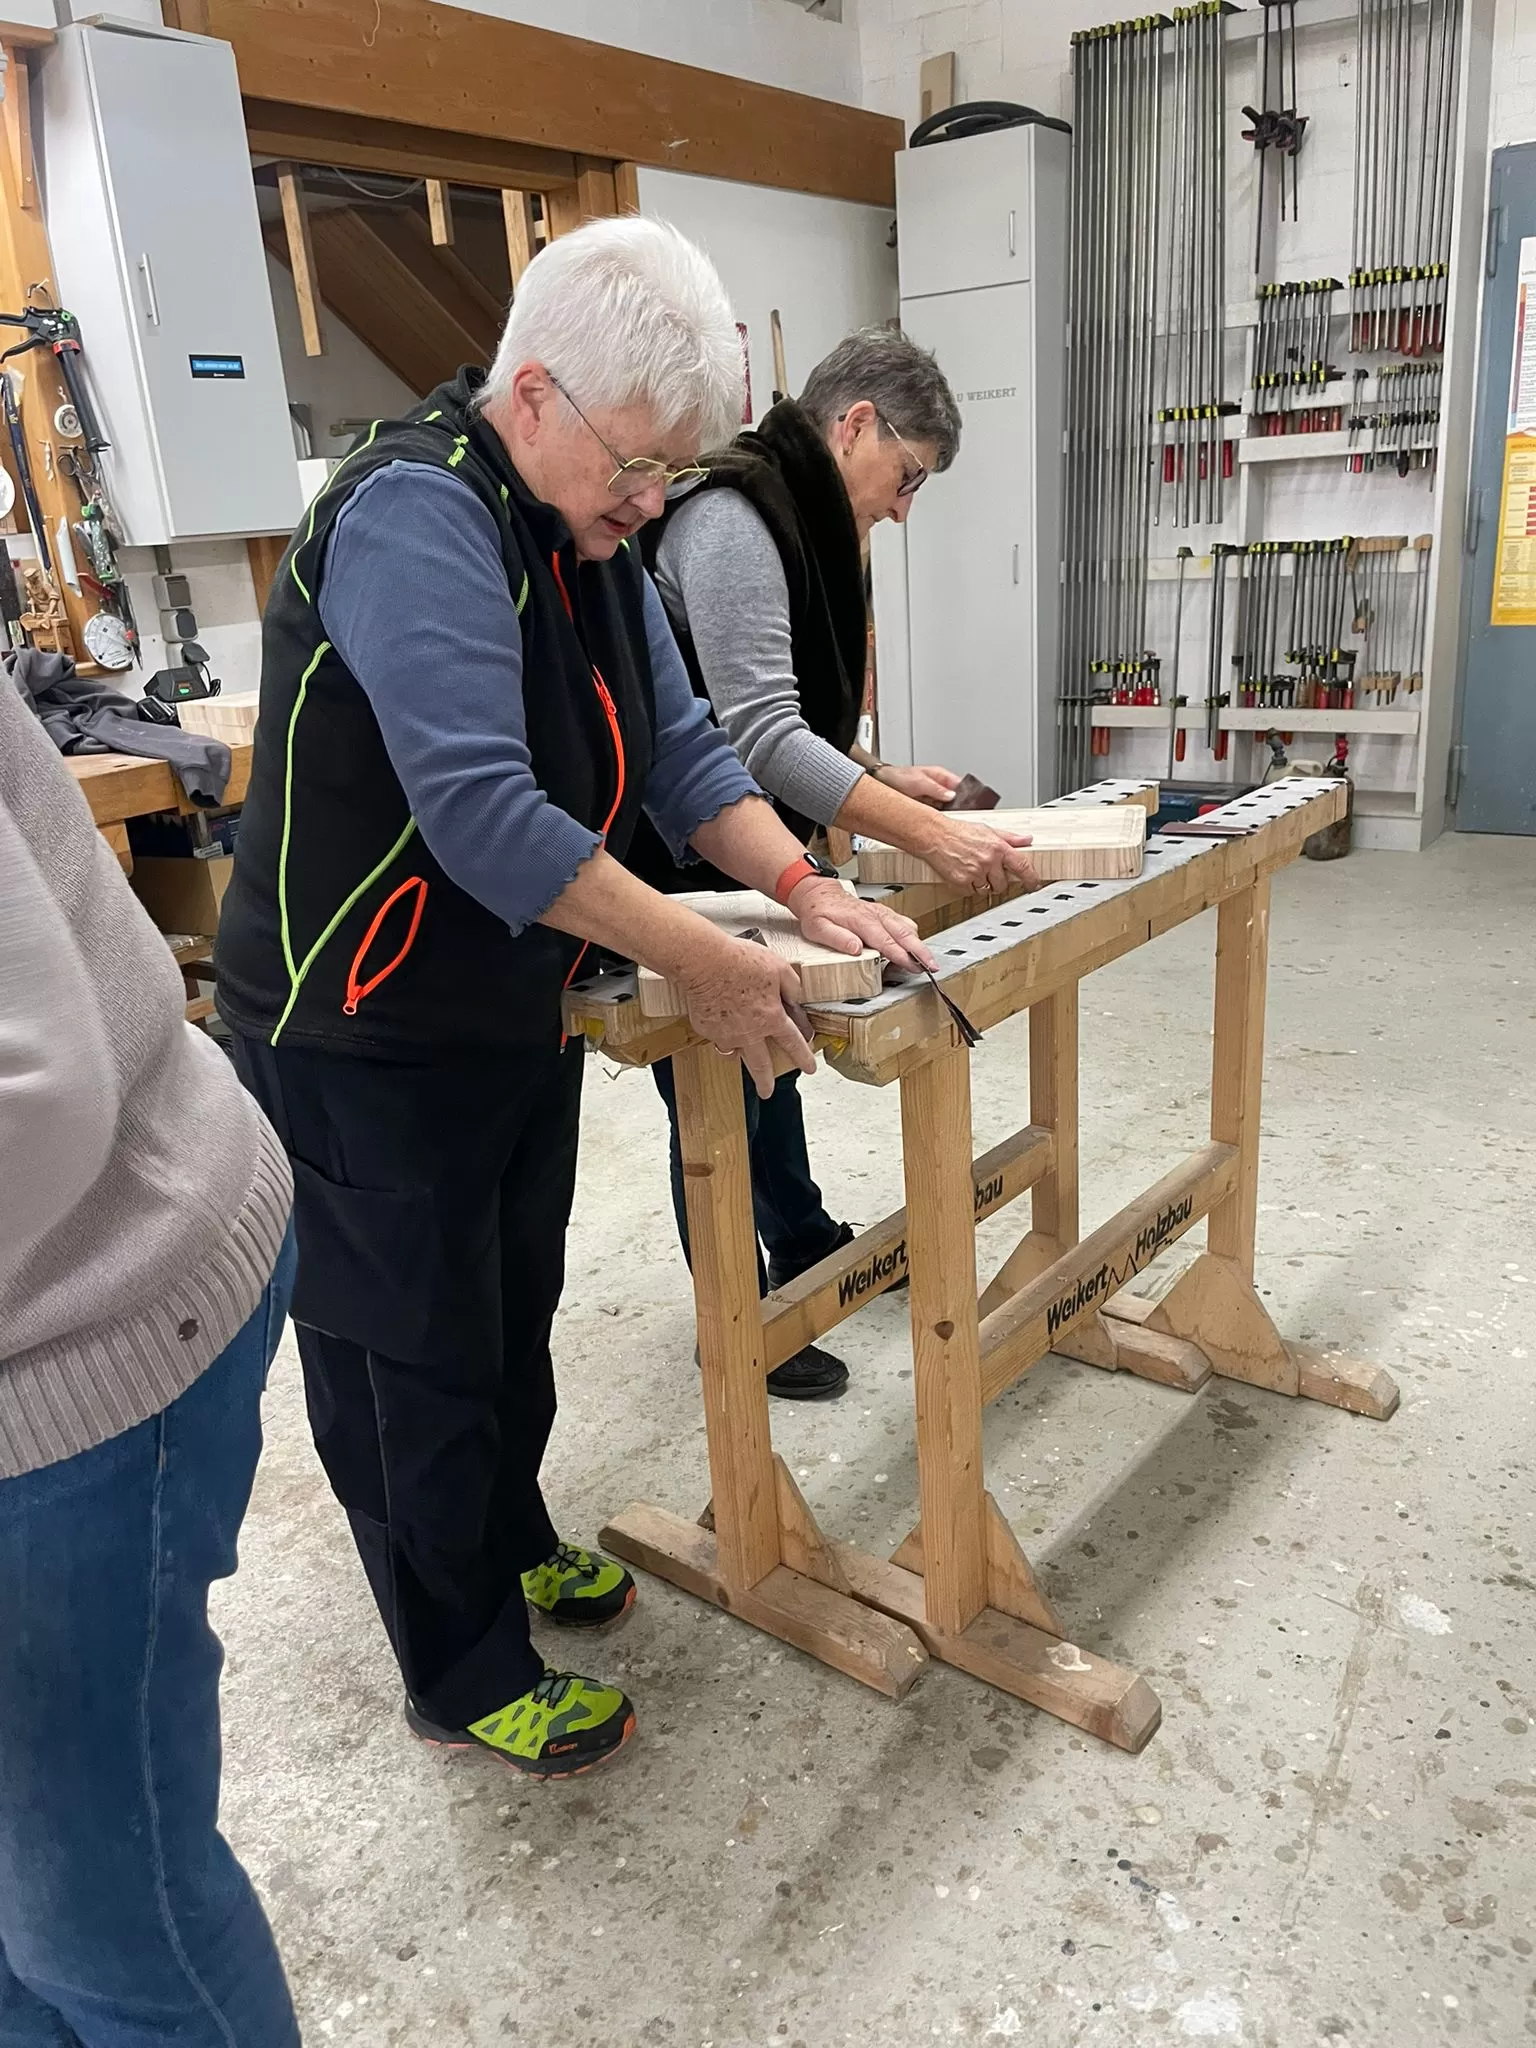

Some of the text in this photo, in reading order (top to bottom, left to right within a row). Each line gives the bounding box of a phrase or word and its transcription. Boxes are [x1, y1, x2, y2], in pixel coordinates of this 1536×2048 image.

[956, 387, 1017, 403] U WEIKERT
[838, 1174, 1004, 1308] Weikert bau
[1047, 1194, 1193, 1335] Weikert Holzbau
